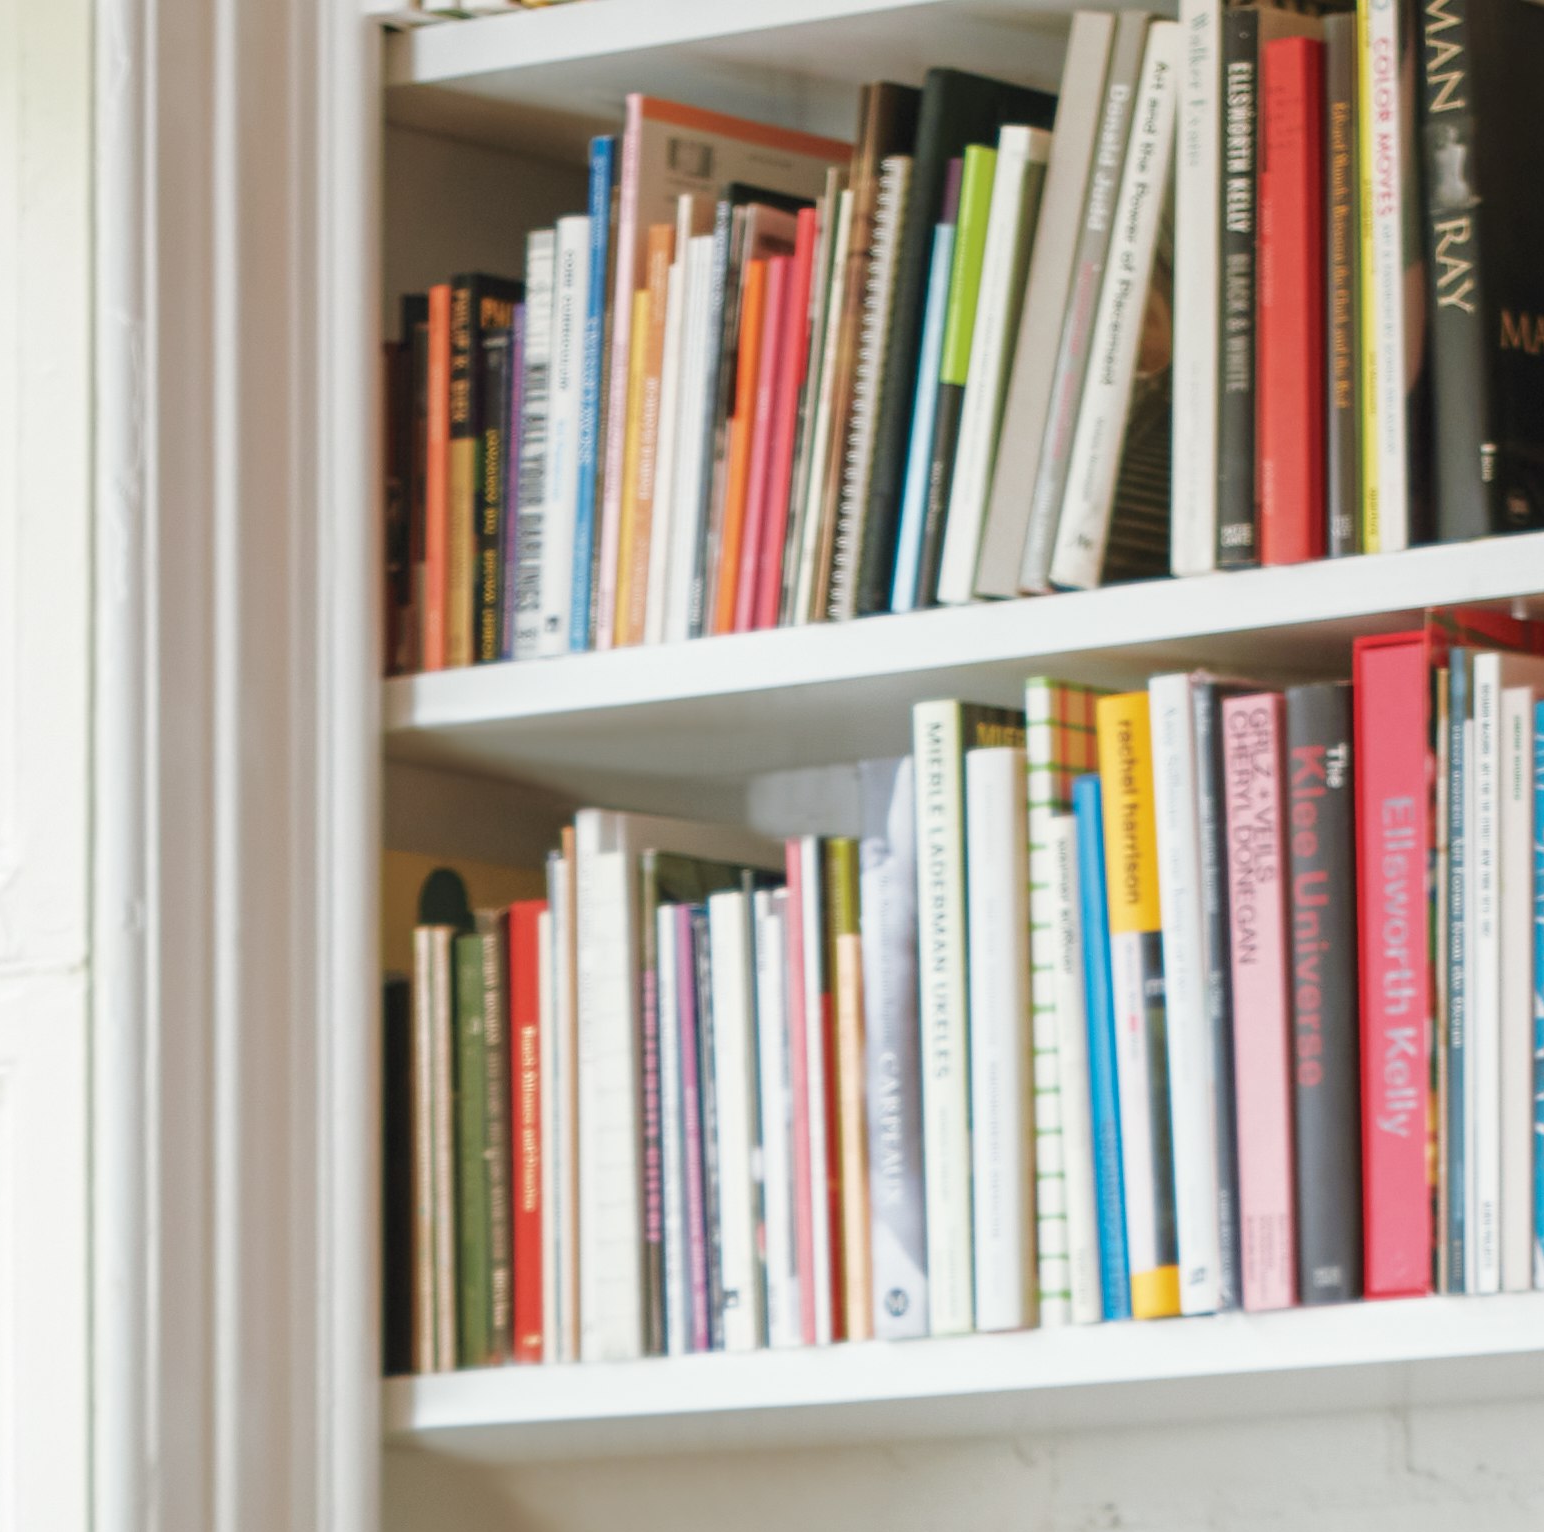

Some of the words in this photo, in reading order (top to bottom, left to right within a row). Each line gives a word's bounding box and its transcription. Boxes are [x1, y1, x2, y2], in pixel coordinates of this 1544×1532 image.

[1151, 60, 1170, 91] Art
[1373, 37, 1393, 123] COLOR
[1425, 0, 1468, 114] MAN
[1094, 83, 1130, 167] Donald
[1137, 141, 1157, 172] the
[1145, 96, 1164, 135] and
[1227, 62, 1256, 174] ELLSWORTH
[1085, 171, 1116, 230] Judd
[1121, 182, 1150, 242] Power
[1225, 178, 1252, 233] KELLY
[1375, 133, 1395, 216] MOVES
[1118, 250, 1139, 273] of
[1225, 253, 1250, 313] BLACK
[1433, 216, 1475, 314] RAY
[1098, 279, 1138, 386] Placement
[1116, 718, 1144, 796] rachel
[1228, 711, 1251, 816] CHERYL
[1249, 709, 1272, 780] GRLZ
[1325, 744, 1347, 788] The
[1290, 746, 1327, 858] Klee
[1122, 802, 1145, 906] harrison
[1256, 807, 1276, 883] VEILS
[1233, 825, 1257, 966] DONEGAN
[1381, 797, 1419, 1016] Ellsworth
[1294, 871, 1332, 1087] Universe
[1376, 1027, 1424, 1138] Kelly
